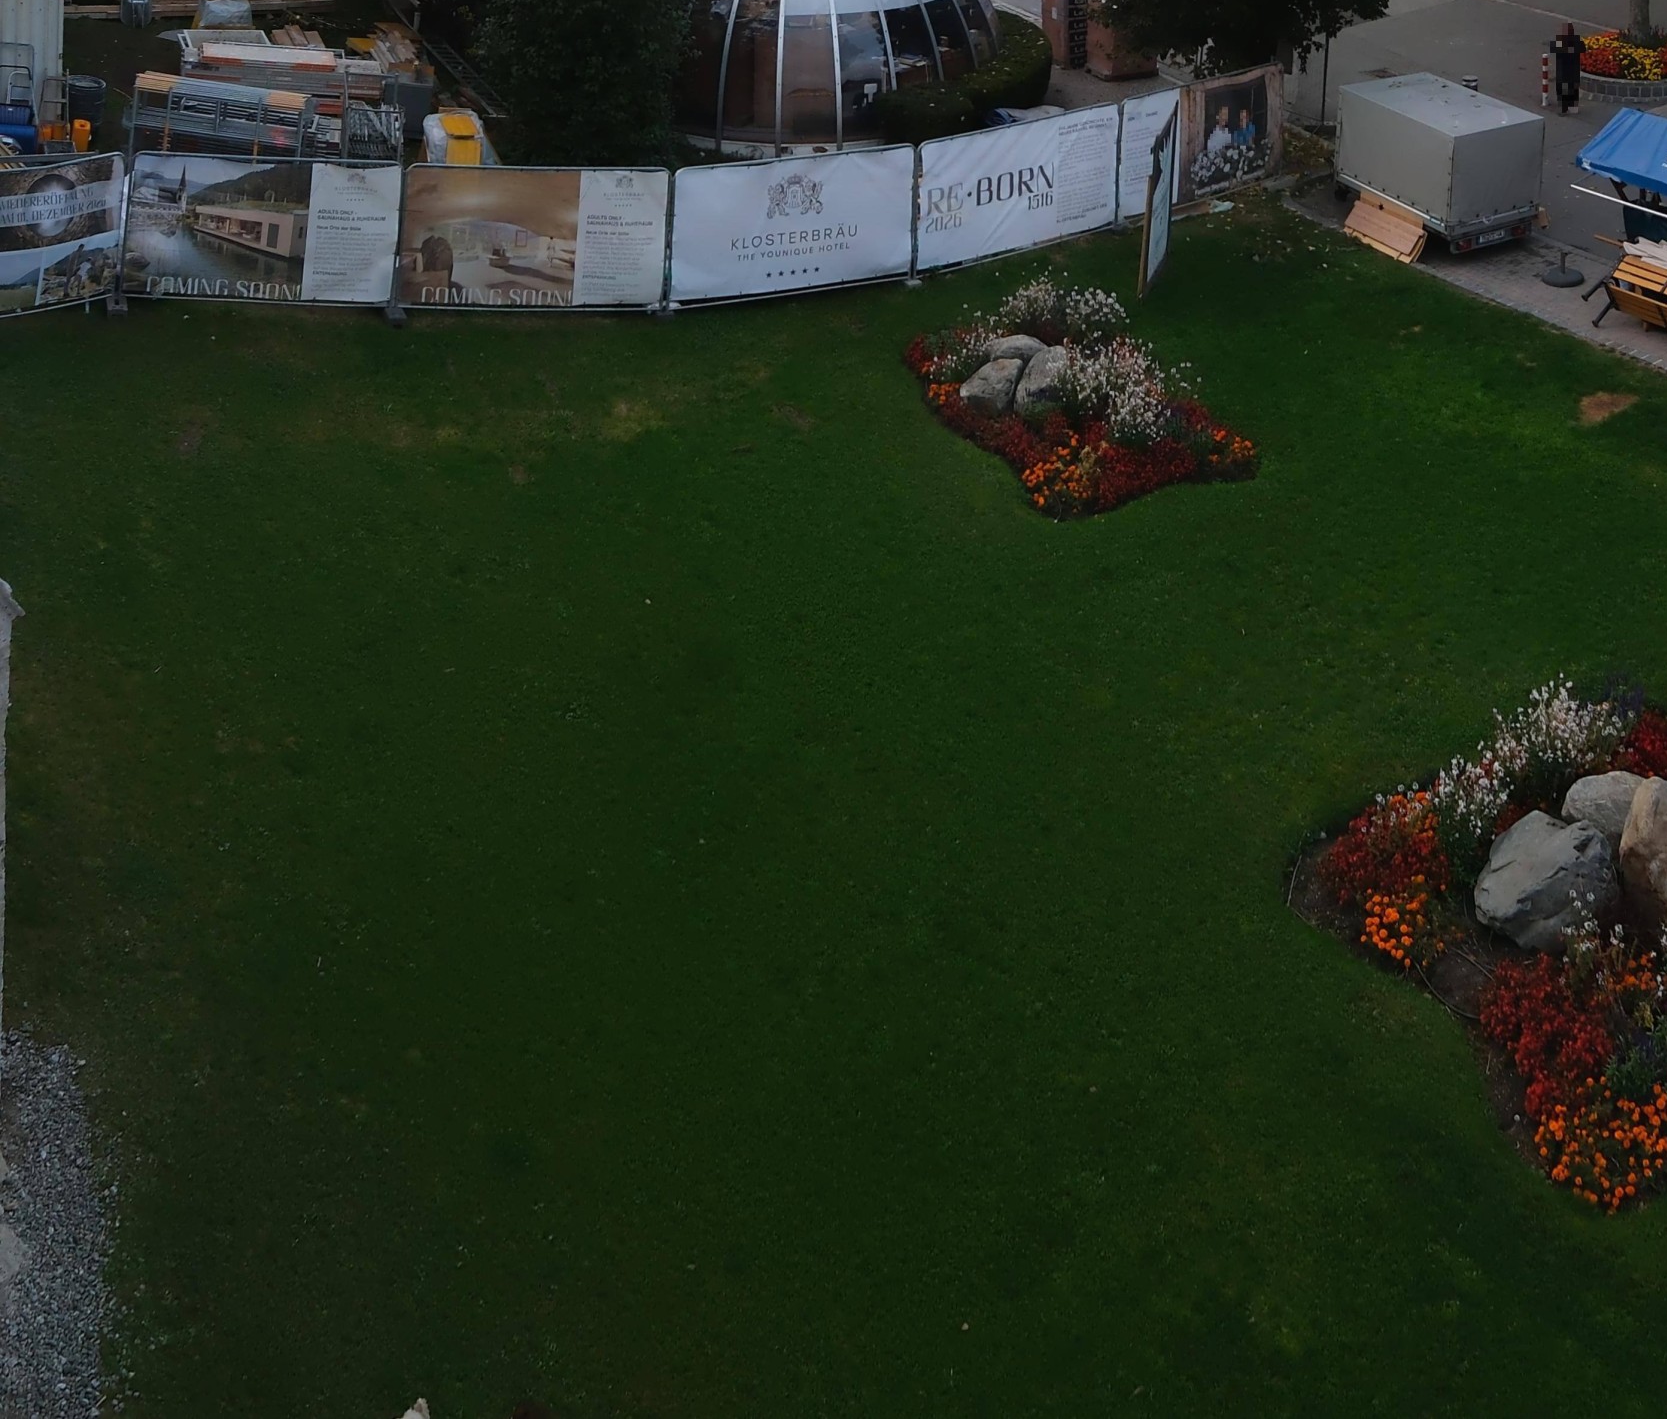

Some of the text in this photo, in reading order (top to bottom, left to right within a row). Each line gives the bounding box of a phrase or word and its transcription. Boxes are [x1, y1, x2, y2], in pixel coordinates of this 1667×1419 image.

[1027, 190, 1054, 211] 1516
[31, 202, 85, 221] DEZEMBER
[925, 212, 963, 234] 2026
[730, 223, 859, 252] KLOSTERBRÄU
[737, 241, 850, 262] THE YOUNIQUE HOTEL
[421, 286, 501, 304] COMING
